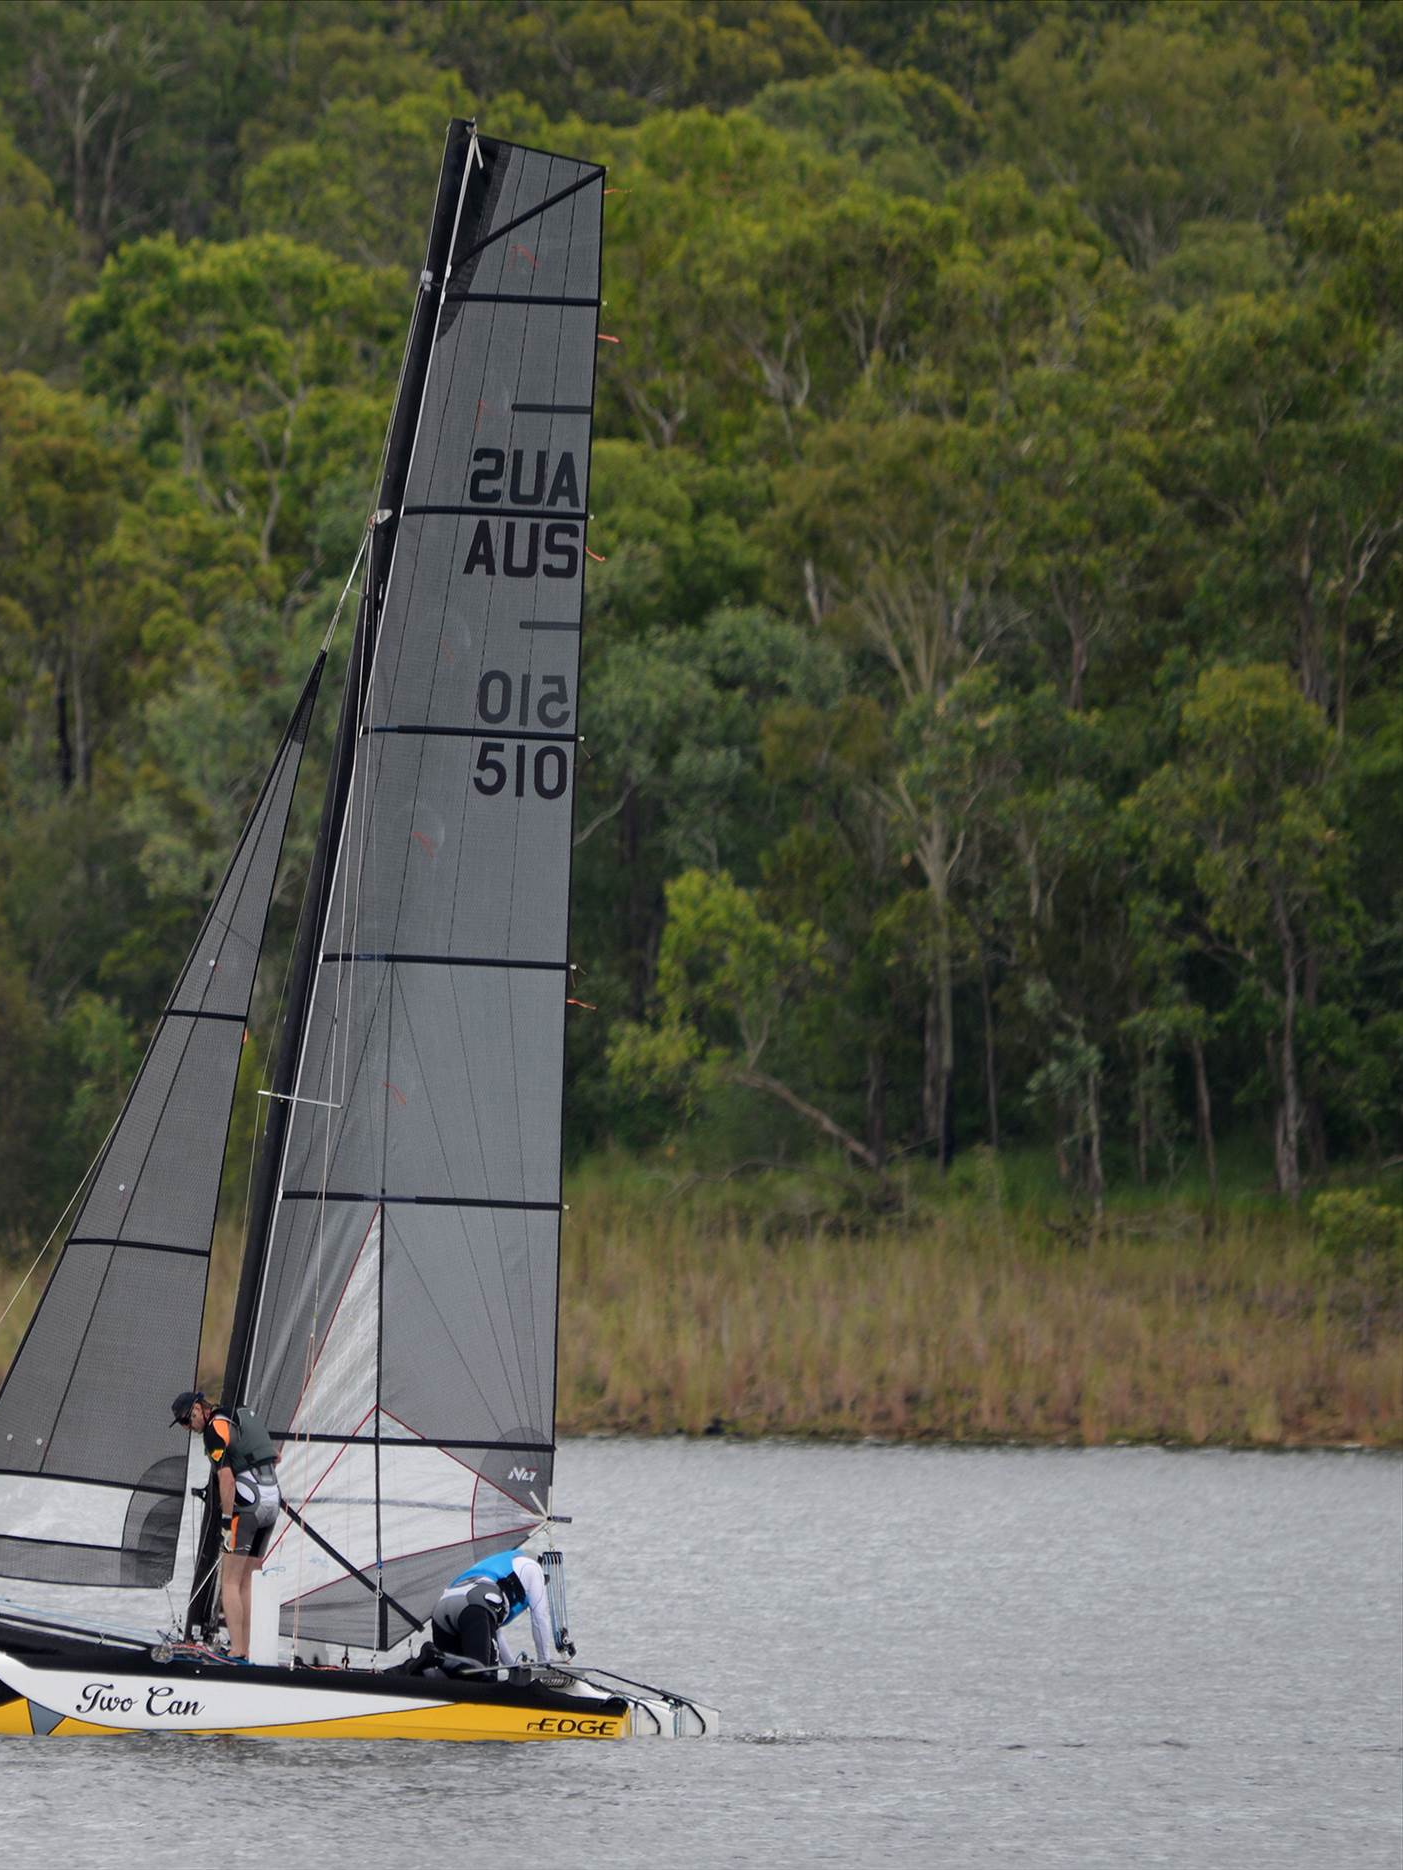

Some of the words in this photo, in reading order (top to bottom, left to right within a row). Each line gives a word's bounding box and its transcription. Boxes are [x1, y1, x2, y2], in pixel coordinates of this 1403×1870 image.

[463, 519, 579, 579] AUS
[473, 742, 567, 800] 510
[75, 1683, 139, 1714] Two
[146, 1686, 205, 1717] Can
